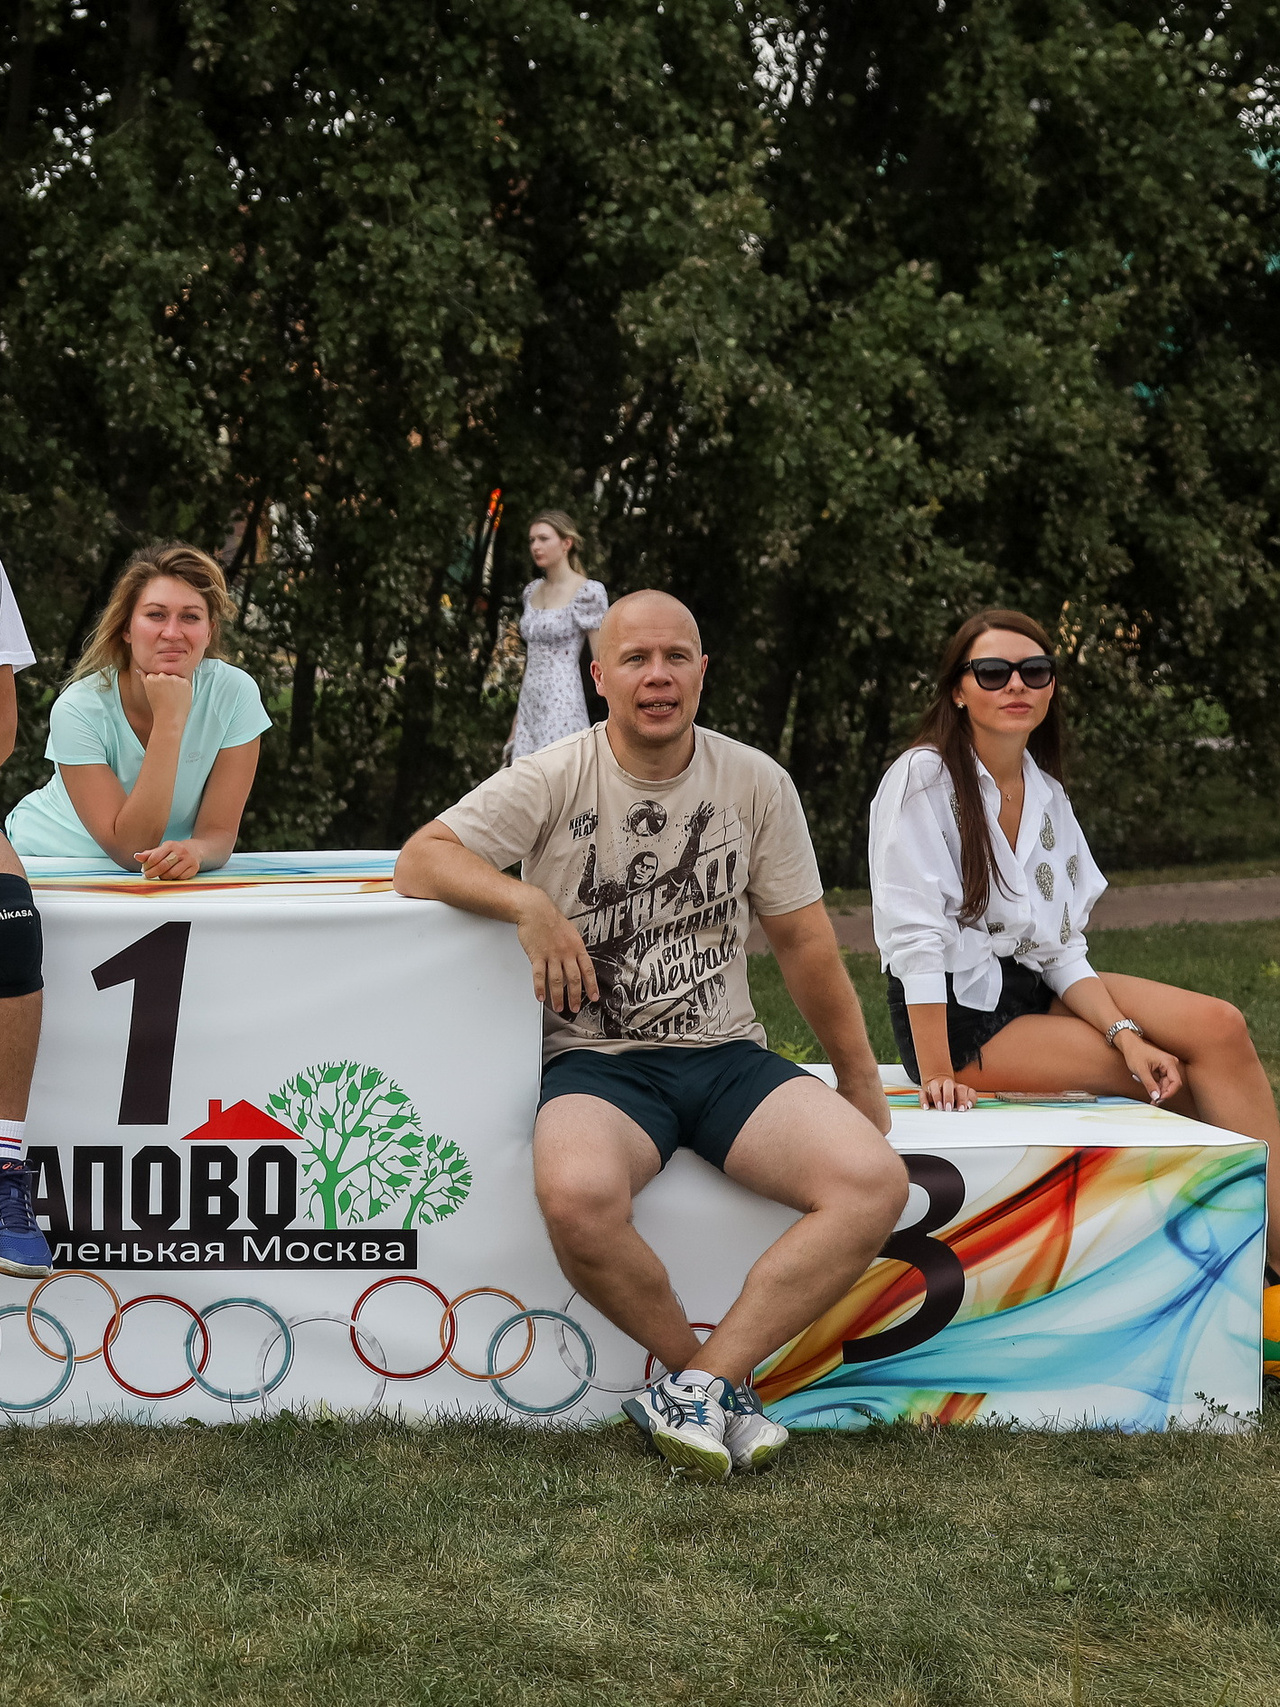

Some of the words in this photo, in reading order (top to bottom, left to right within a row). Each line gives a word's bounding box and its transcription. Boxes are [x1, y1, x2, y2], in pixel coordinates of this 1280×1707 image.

[661, 938, 691, 966] BUT
[91, 921, 192, 1125] 1
[51, 1243, 226, 1263] ленькая
[242, 1235, 406, 1263] Москва
[842, 1154, 966, 1364] 3
